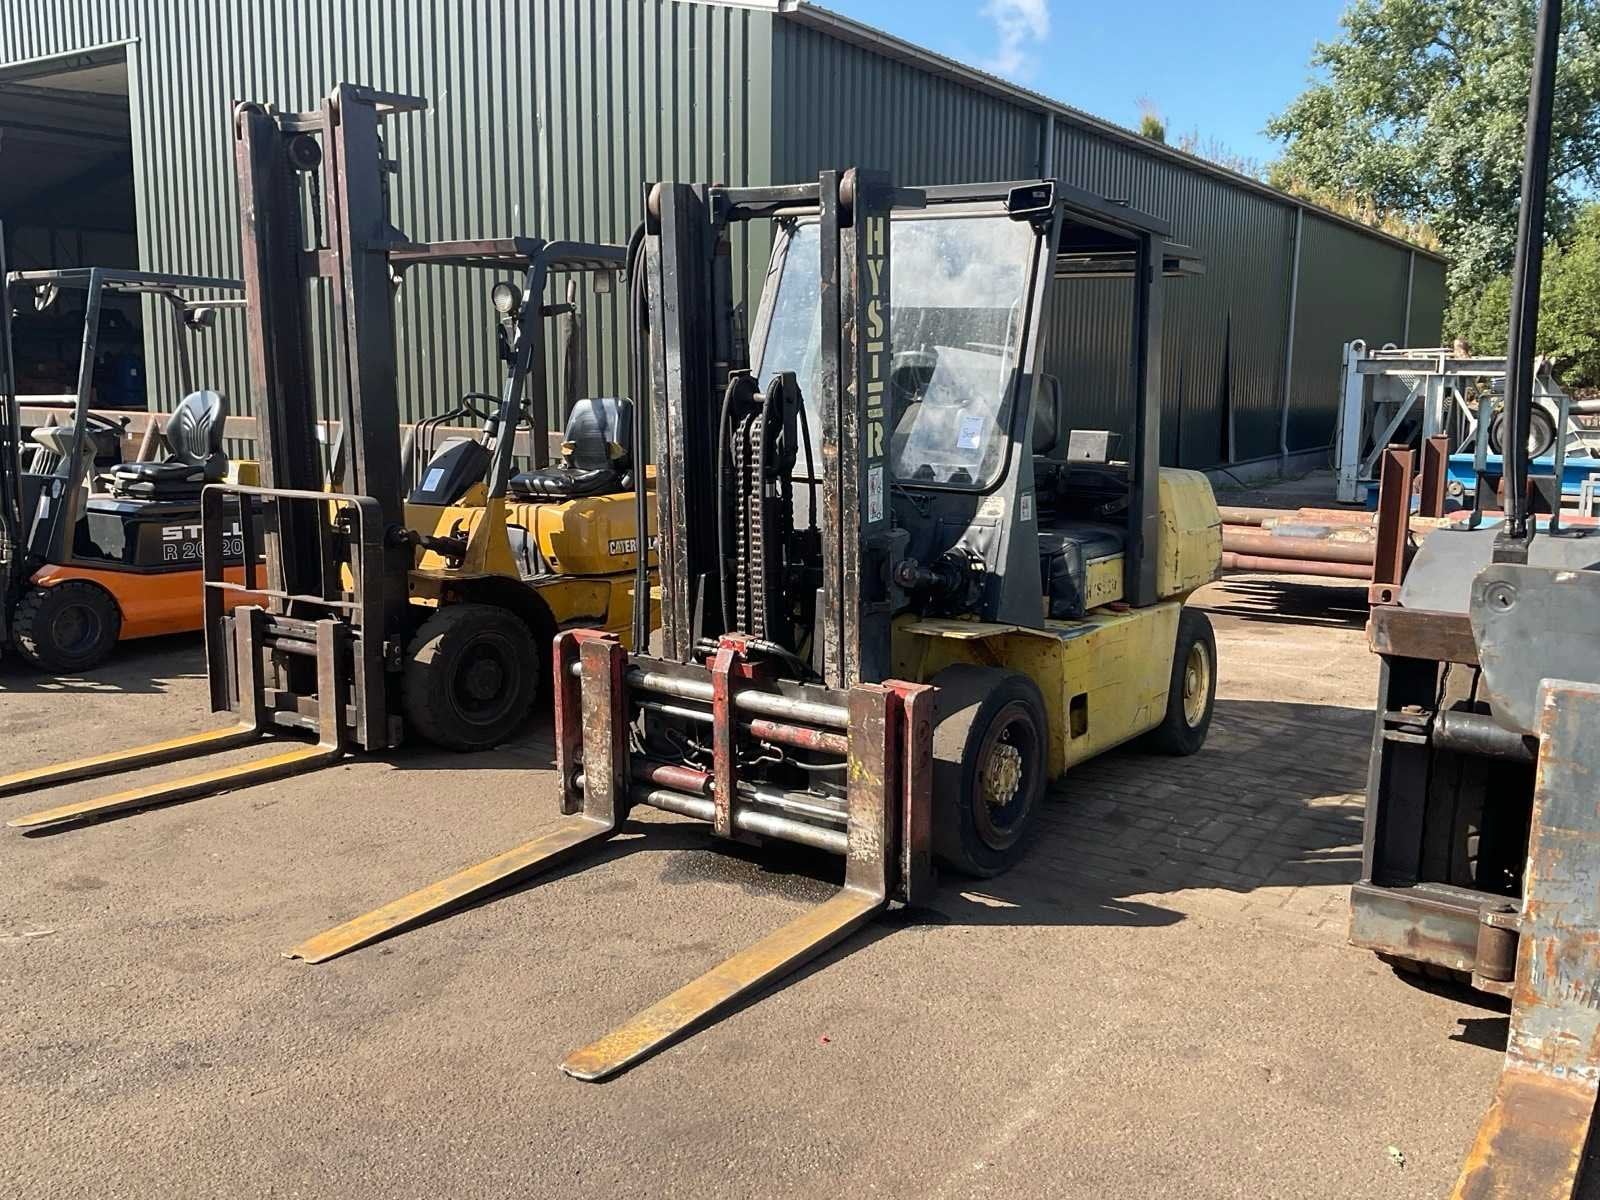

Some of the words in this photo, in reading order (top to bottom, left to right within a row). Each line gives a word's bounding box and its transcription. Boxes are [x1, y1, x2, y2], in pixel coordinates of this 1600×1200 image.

[866, 216, 884, 458] HYSTER
[162, 522, 242, 541] STL
[163, 543, 178, 561] R
[182, 538, 243, 559] 2020
